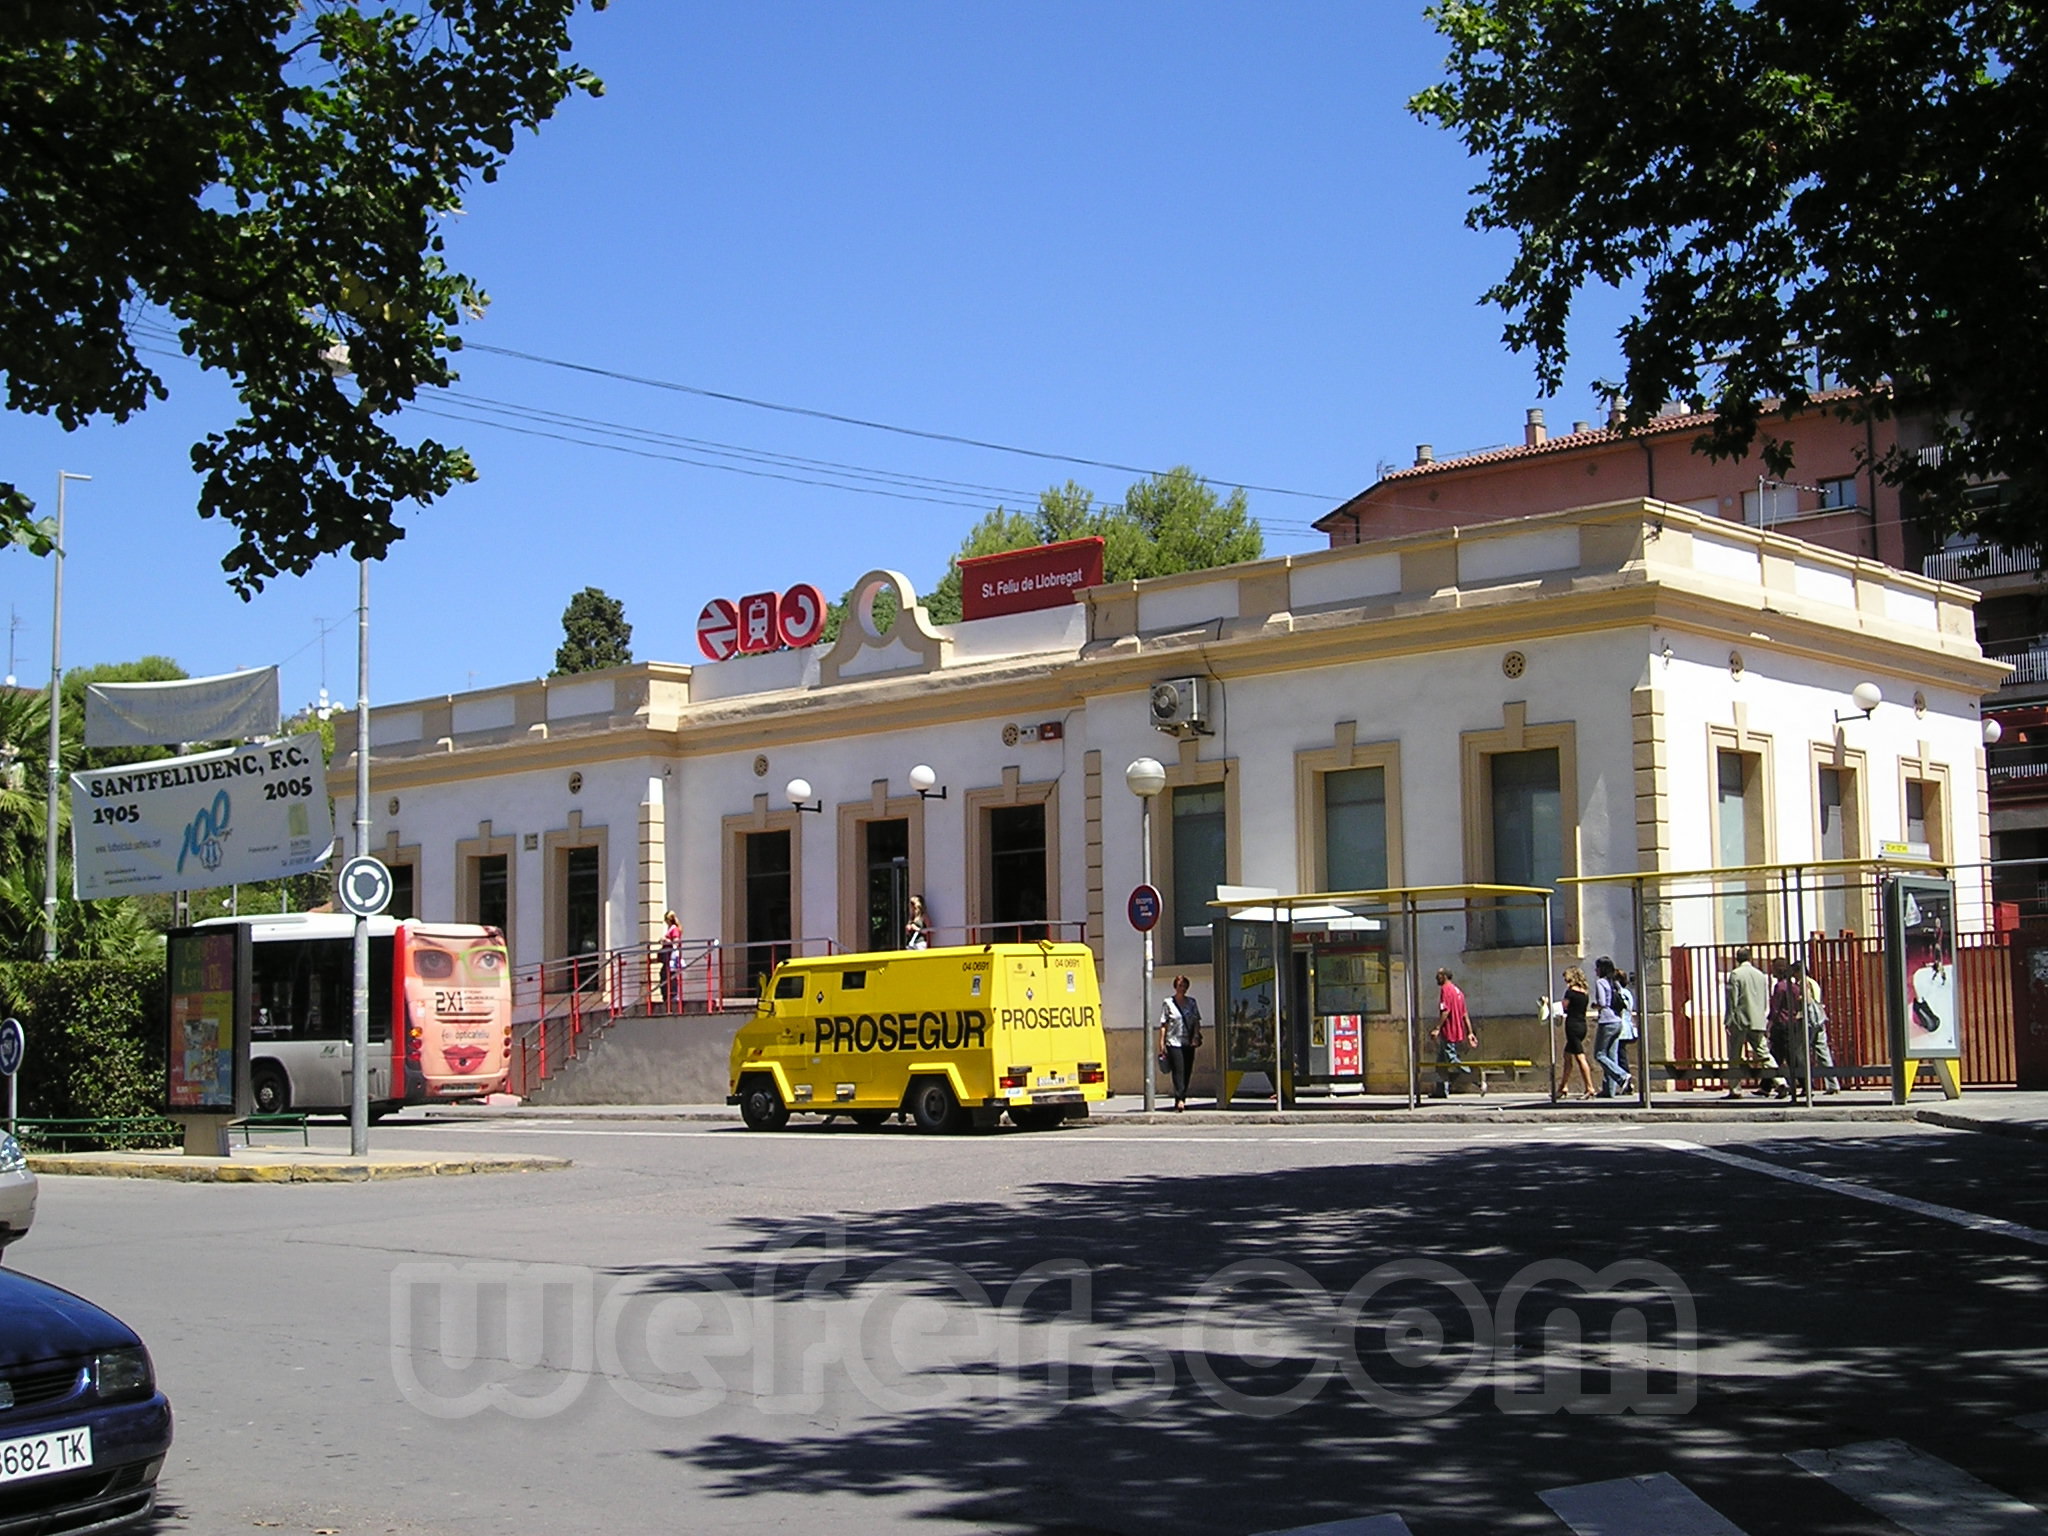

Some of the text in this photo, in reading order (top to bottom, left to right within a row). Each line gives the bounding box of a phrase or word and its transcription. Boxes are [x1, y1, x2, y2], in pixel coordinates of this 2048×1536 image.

[982, 567, 1083, 599] St. Feliu de Llobregat
[91, 747, 309, 798] SANTFELIUENC, F.C.
[264, 776, 313, 800] 2005
[93, 804, 140, 825] 1905
[176, 788, 231, 874] 100
[435, 991, 464, 1012] 2X1
[814, 1010, 987, 1054] PROSEGUR
[1002, 1007, 1095, 1031] PROSEGUR
[0, 1433, 86, 1476] 682 TK
